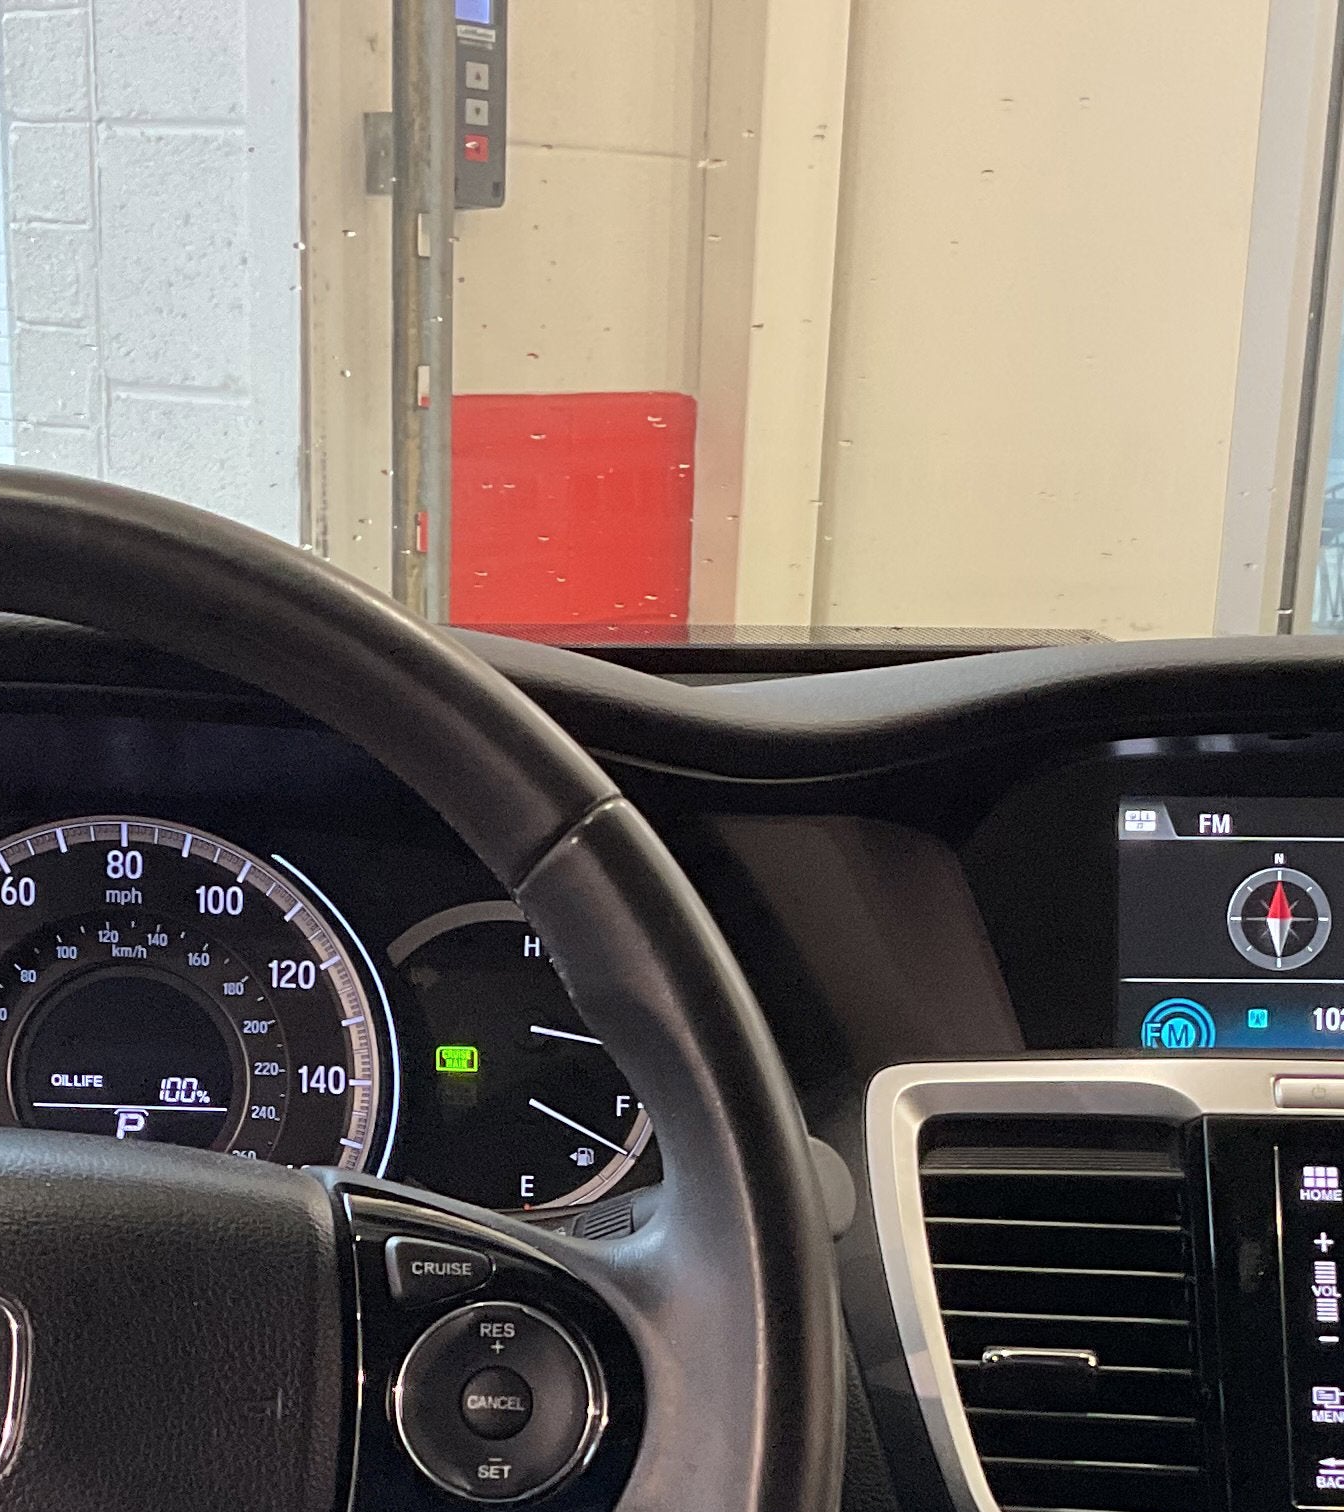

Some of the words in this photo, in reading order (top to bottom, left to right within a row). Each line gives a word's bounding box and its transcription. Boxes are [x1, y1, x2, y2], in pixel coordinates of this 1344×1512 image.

[1199, 814, 1231, 834] FM
[106, 850, 143, 879] 80
[1274, 853, 1284, 864] N
[0, 876, 36, 905] 60
[106, 888, 142, 906] mph
[196, 887, 244, 915] 100
[98, 930, 119, 943] 120
[147, 933, 168, 947] 140
[56, 946, 77, 959] 100
[112, 945, 147, 960] km/h
[523, 935, 540, 957] H
[187, 952, 210, 967] 160
[20, 969, 36, 983] 80
[268, 961, 316, 990] 120
[223, 982, 244, 996] 180
[243, 1020, 268, 1034] 200
[254, 1062, 279, 1076] 220
[298, 1065, 346, 1095] 140
[251, 1105, 275, 1119] 240
[616, 1095, 630, 1117] F
[116, 1112, 145, 1140] P
[521, 1175, 534, 1197] E
[1300, 1189, 1343, 1201] HOME
[411, 1261, 473, 1276] CRUISE
[1311, 1285, 1341, 1298] VOL
[480, 1323, 515, 1337] RES
[467, 1395, 525, 1411] CANCEL
[477, 1465, 512, 1479] SET
